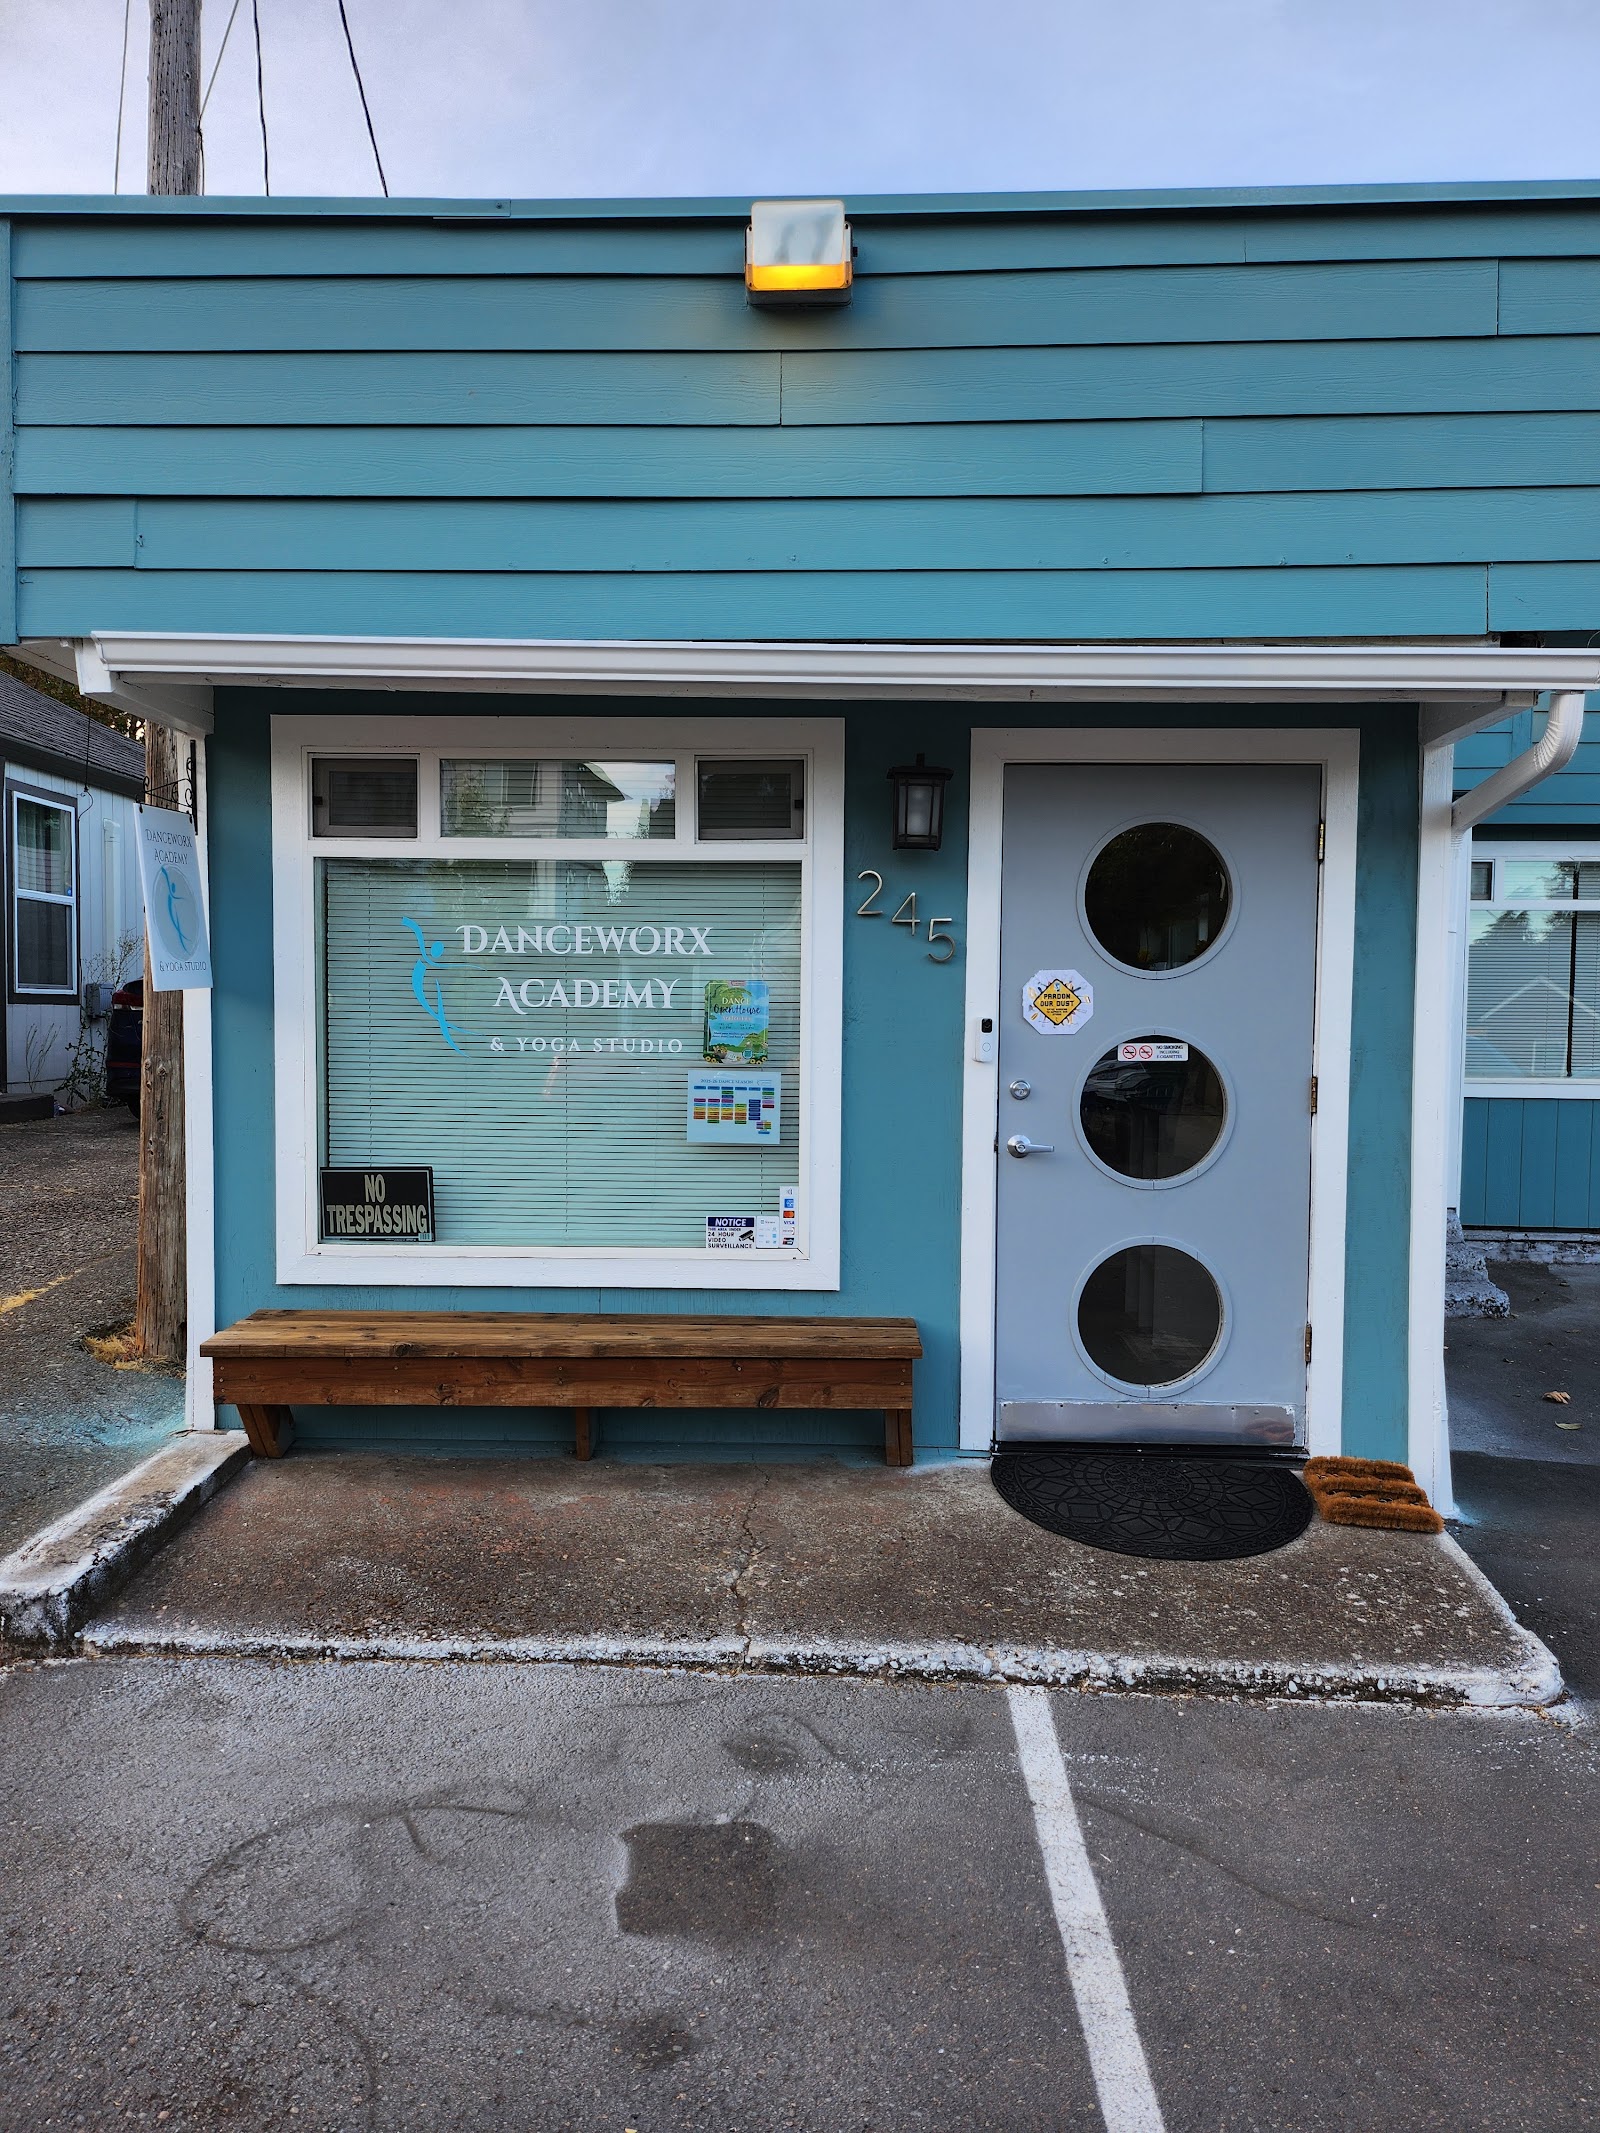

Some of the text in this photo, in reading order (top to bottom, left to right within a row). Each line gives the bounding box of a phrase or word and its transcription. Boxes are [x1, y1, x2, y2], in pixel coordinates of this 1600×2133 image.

[145, 829, 193, 848] DANCEWORX
[154, 849, 188, 865] ACADEMY
[456, 925, 715, 955] DANCEWORX
[159, 961, 207, 971] & YOGA STUDIO
[492, 976, 681, 1015] ACADEMY
[490, 1037, 684, 1053] & YOGA STUDIO
[364, 1173, 386, 1203] NO
[326, 1204, 428, 1234] TRESPASSING
[714, 1218, 747, 1227] NOTICE
